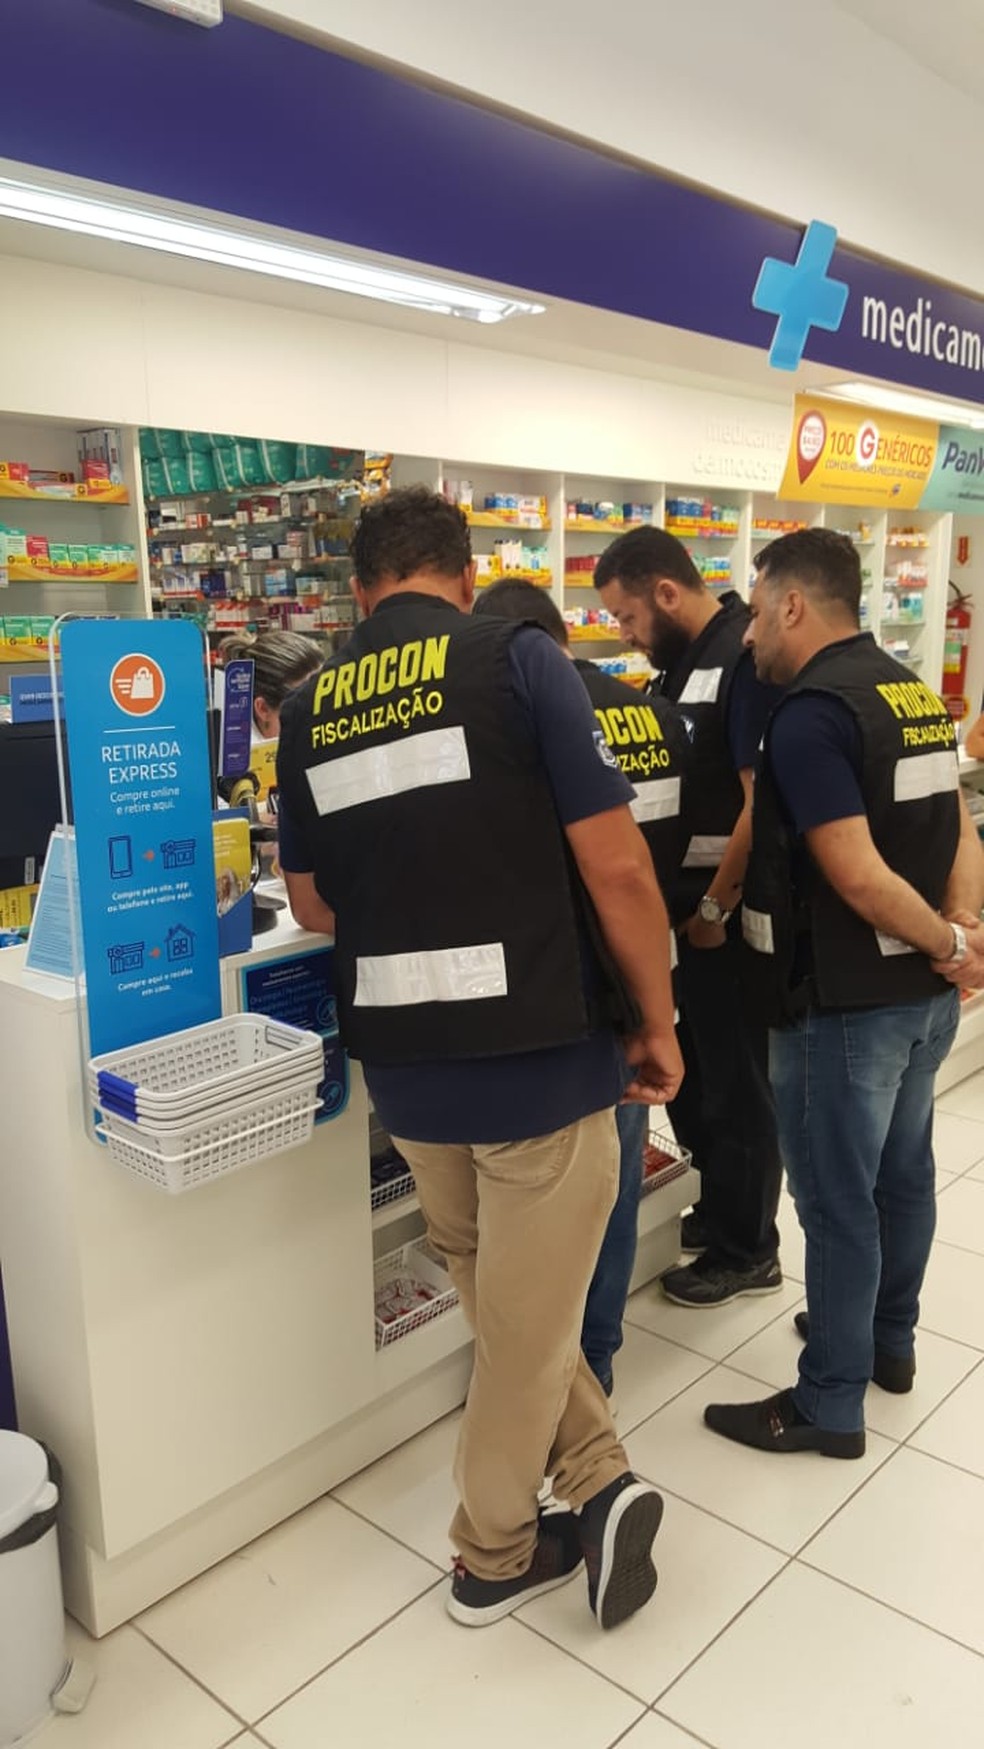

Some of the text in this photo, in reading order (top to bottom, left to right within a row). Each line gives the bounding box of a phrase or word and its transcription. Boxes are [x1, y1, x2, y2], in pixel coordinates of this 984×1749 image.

[830, 430, 856, 456] 100
[313, 634, 450, 716] PROCON
[311, 687, 443, 749] FISCALIZAÇÃO
[101, 741, 181, 763] RETIRADA
[109, 761, 178, 784] EXPRESS
[110, 787, 180, 803] Compre online
[116, 799, 176, 815] e retire aqui.
[112, 889, 140, 901] Compre
